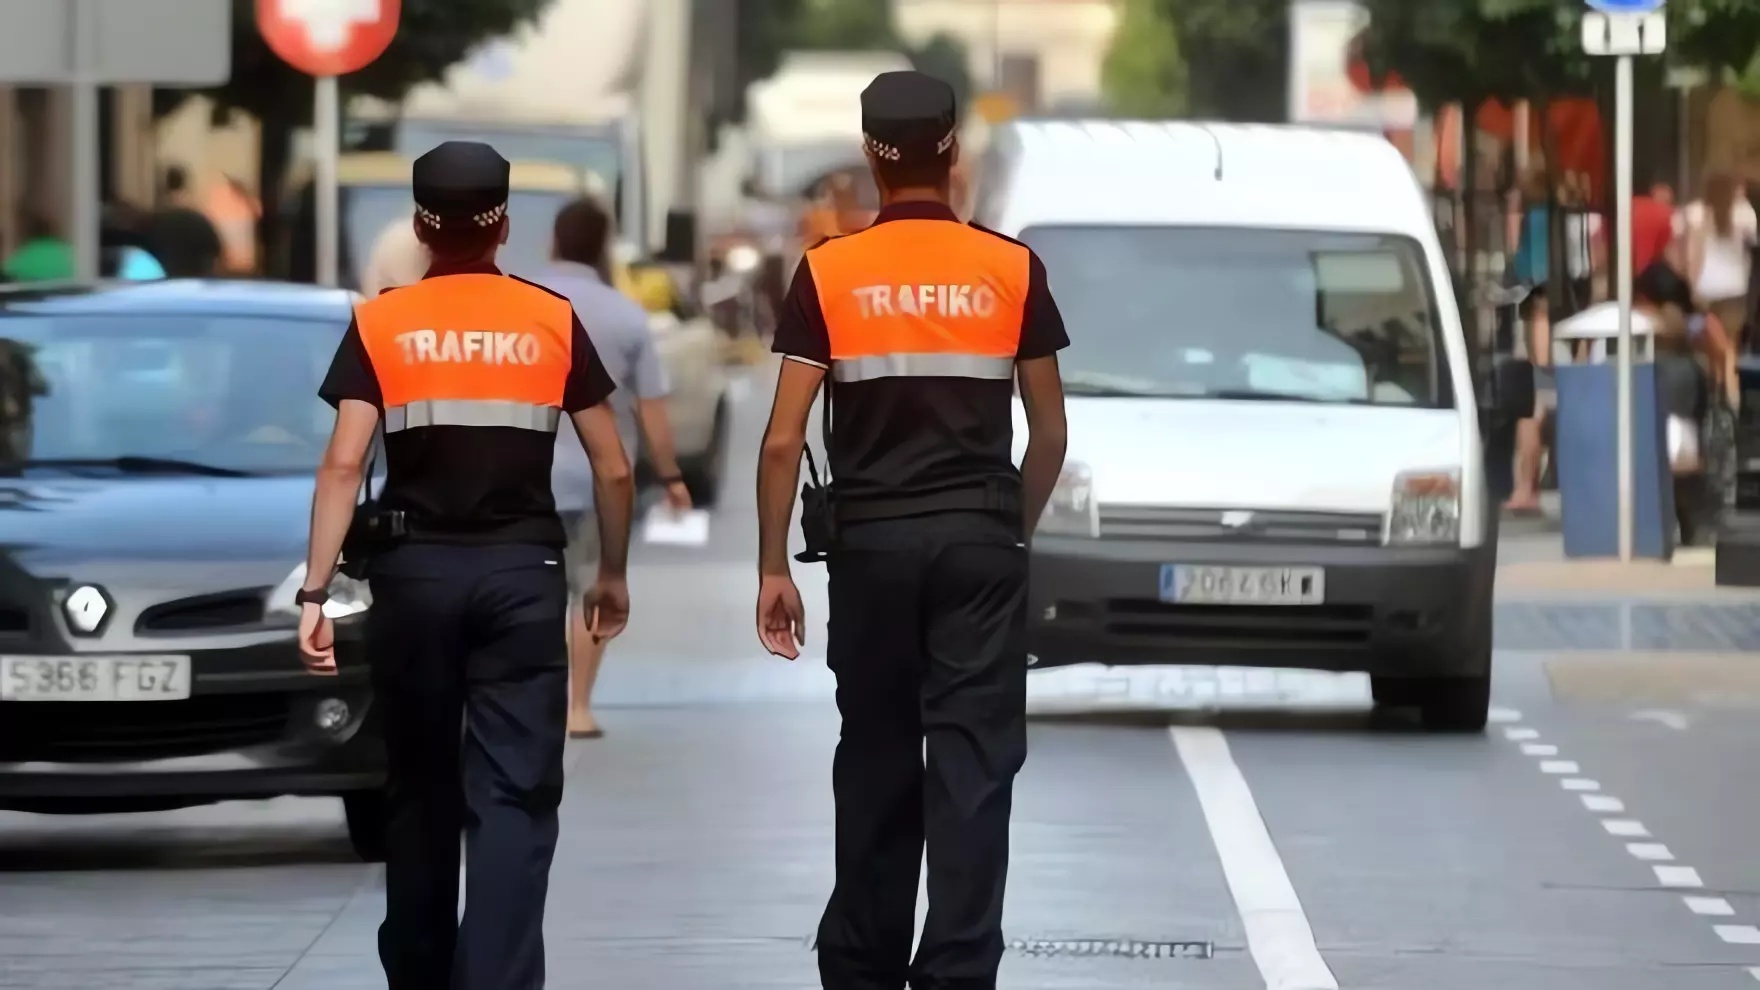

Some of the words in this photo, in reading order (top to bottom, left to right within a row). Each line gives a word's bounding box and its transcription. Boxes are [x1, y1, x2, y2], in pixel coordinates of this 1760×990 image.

[851, 284, 996, 320] TRAFIKO
[394, 329, 540, 366] TRAFIKO
[112, 660, 178, 693] FGZ
